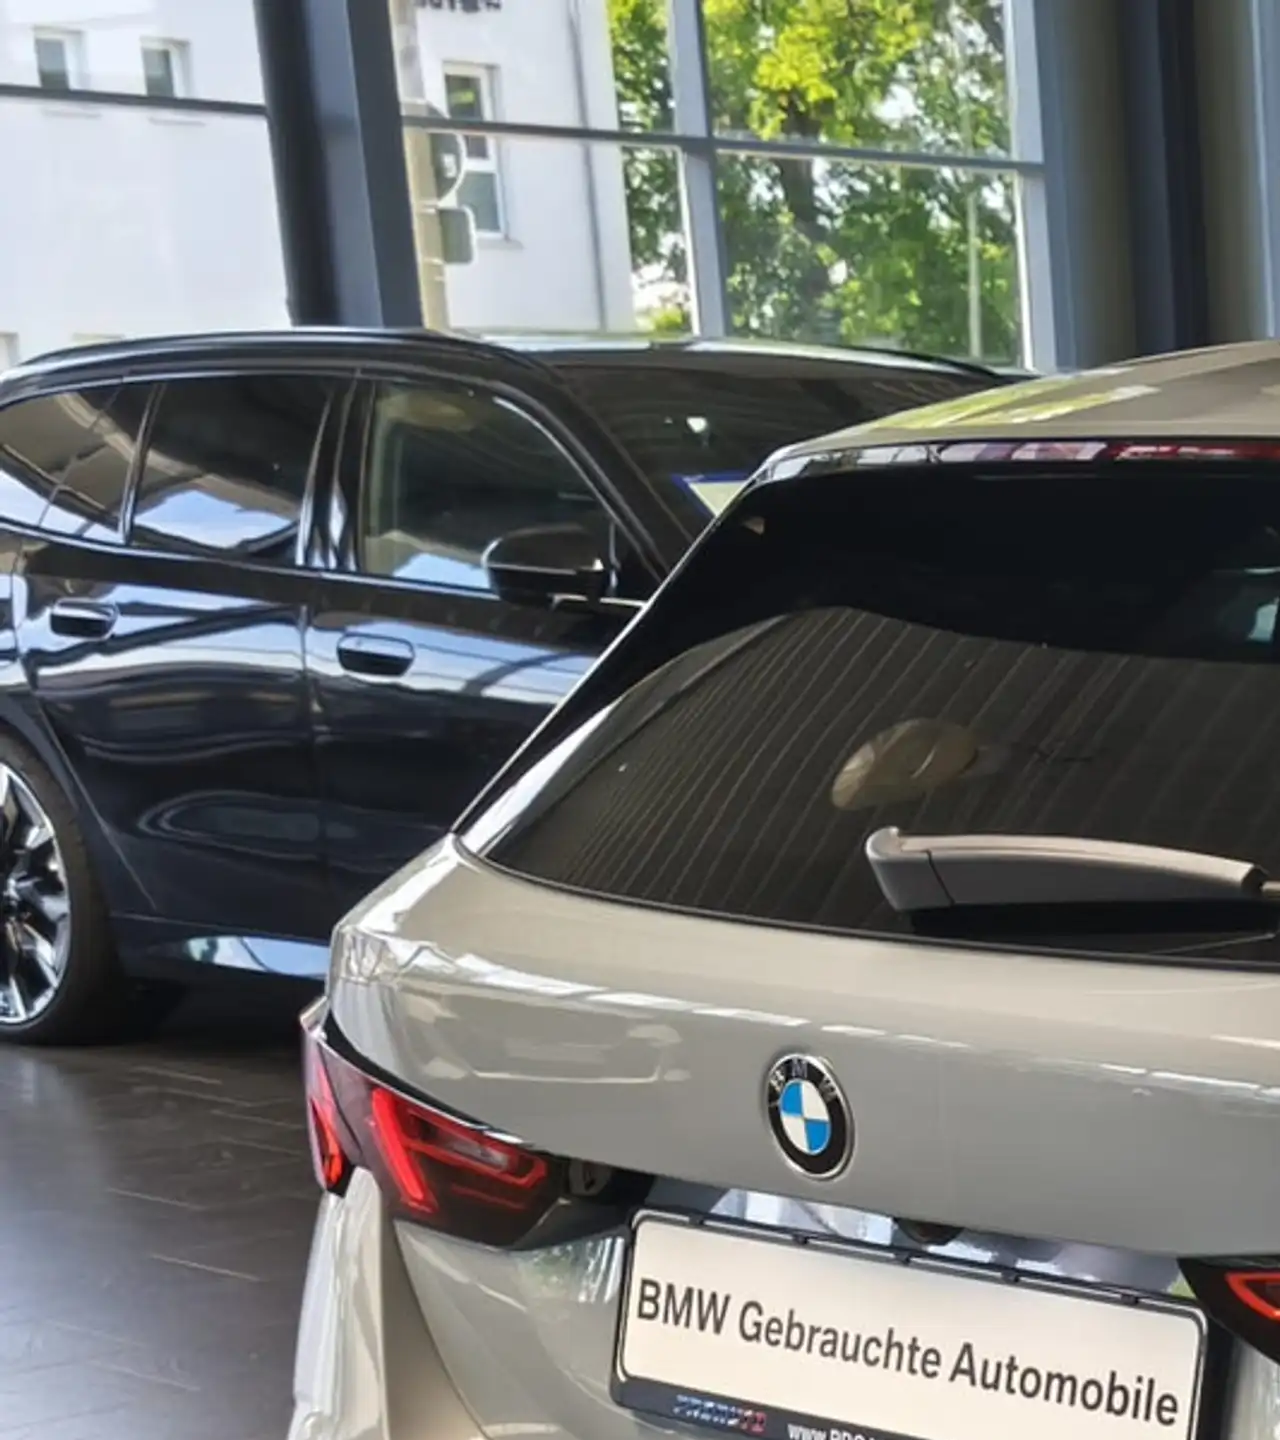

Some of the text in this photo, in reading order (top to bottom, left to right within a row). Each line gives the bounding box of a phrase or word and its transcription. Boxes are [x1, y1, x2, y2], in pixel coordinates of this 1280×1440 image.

[636, 1276, 1180, 1427] BMW Gebrauchte Automobile
